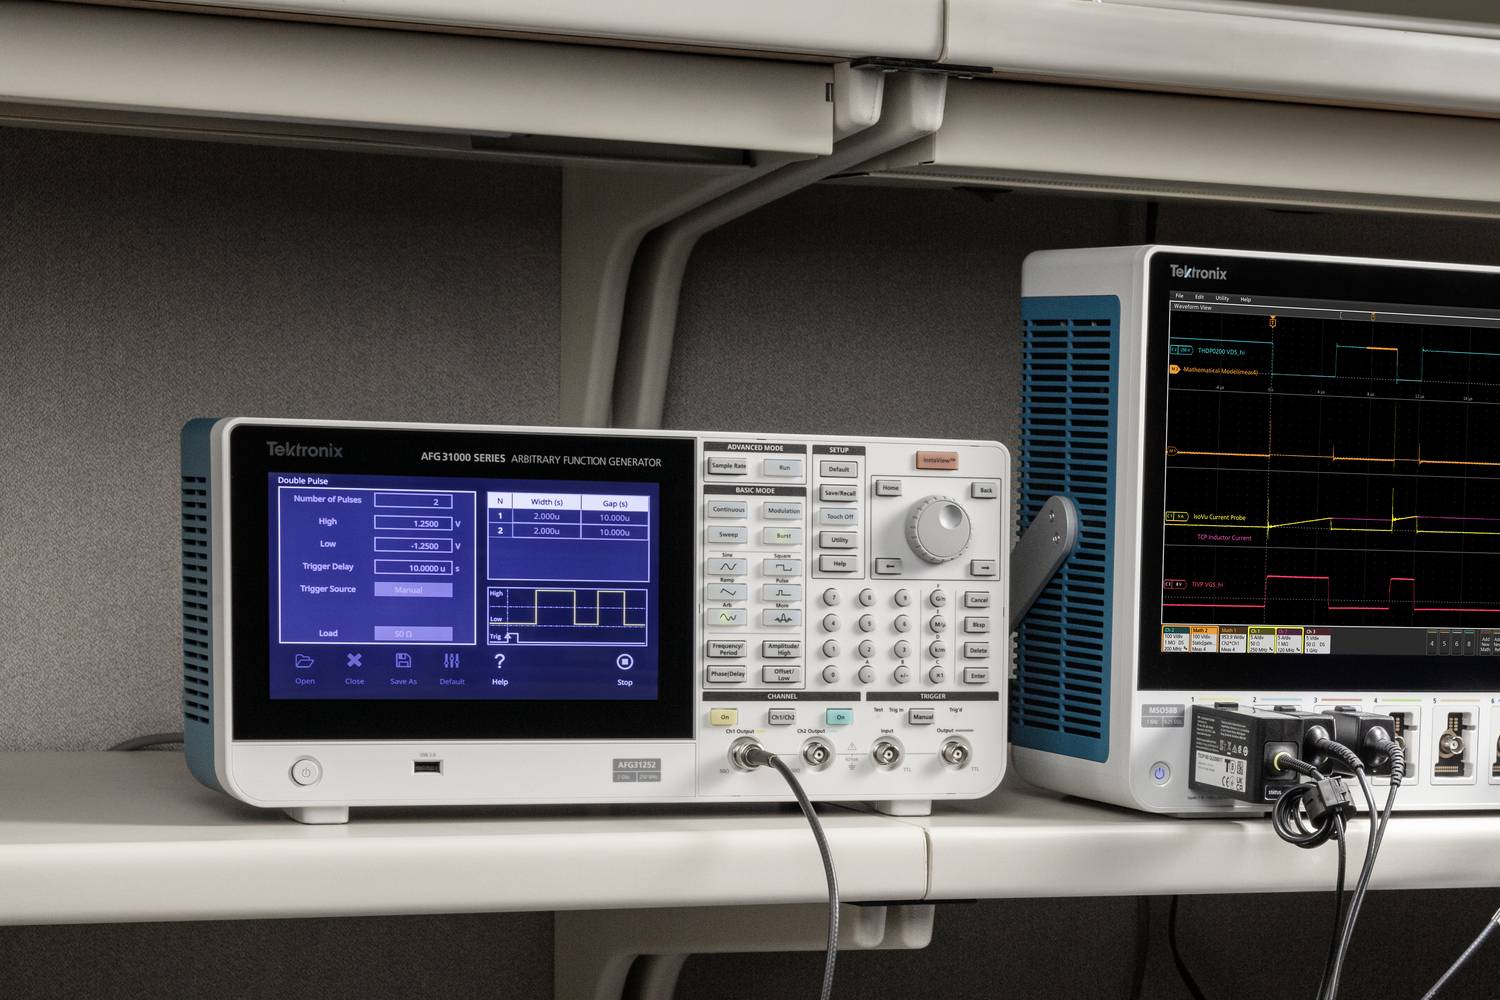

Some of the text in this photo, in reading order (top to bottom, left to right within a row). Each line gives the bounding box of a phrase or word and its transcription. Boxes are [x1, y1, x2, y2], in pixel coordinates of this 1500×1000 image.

[1169, 264, 1228, 280] Tektronix
[266, 441, 344, 458] Tektronix
[727, 443, 784, 452] ADVANCED MODE
[421, 452, 662, 467] AFG 31000 SERIES ARBITRARY FUNCTION GENERATOR
[278, 476, 328, 485] Double Pulse
[294, 494, 362, 504] Number of Pulses
[433, 498, 439, 506] 2
[531, 498, 563, 507] Width (s)
[603, 500, 628, 509] Gap (s)
[319, 517, 337, 527] High
[600, 514, 630, 522] 10.000u
[413, 520, 439, 528] 1.2500
[534, 527, 560, 535] 2.000u
[600, 529, 630, 537] 10.000u
[320, 540, 336, 548] Low
[410, 542, 439, 550] -1.2500
[302, 562, 354, 572] Trigger Delay
[409, 564, 438, 572] 10.0000
[300, 585, 328, 594] Trigger
[394, 586, 423, 594] Manual
[295, 678, 315, 687] Open
[492, 679, 509, 687] Help
[617, 679, 633, 687] Stop
[618, 761, 656, 769] AFG31252
